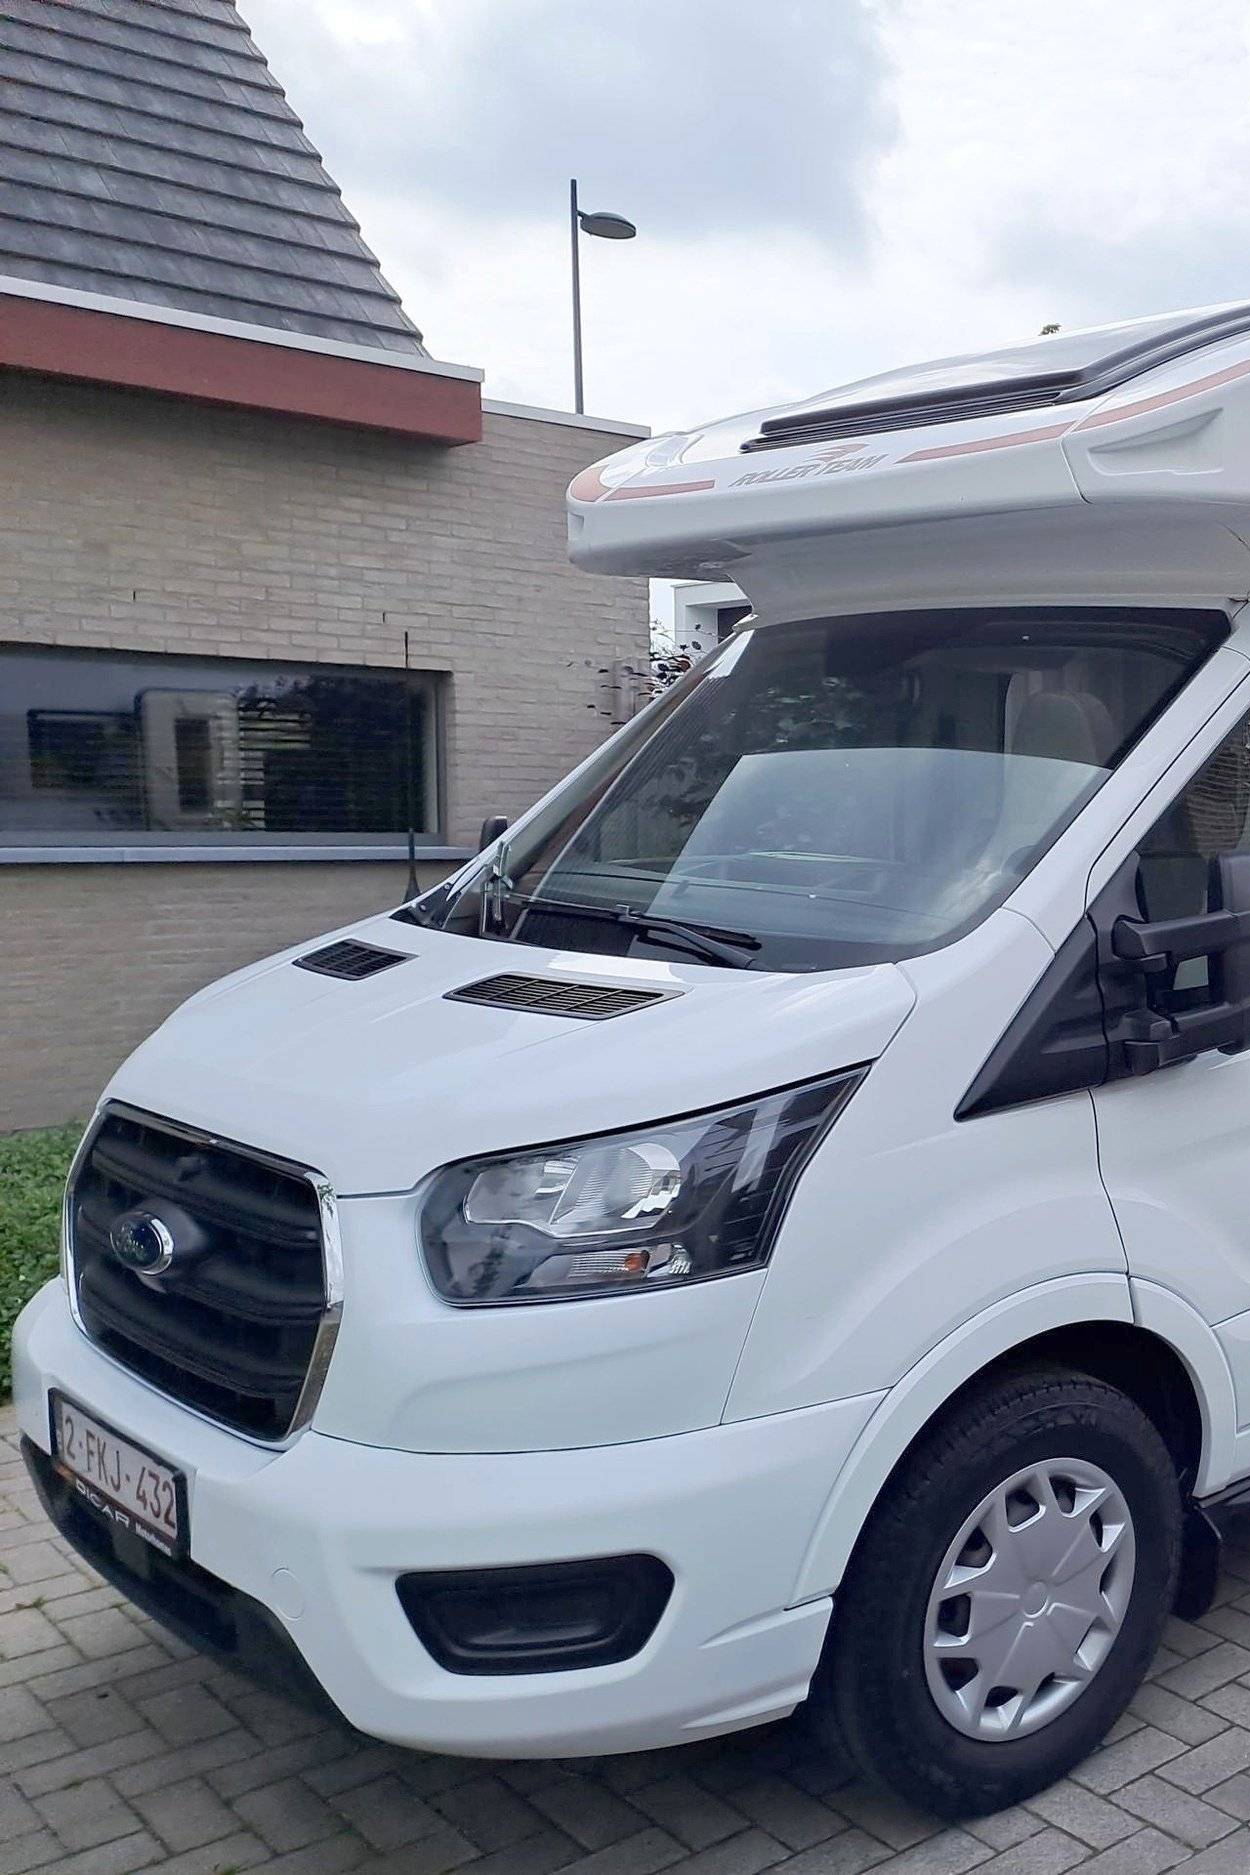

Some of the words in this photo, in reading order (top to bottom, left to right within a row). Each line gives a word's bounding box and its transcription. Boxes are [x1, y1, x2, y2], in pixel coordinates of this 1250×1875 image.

[728, 463, 820, 488] ROLLER
[815, 453, 890, 476] TEAM
[65, 1415, 176, 1530] 2-FKJ-432
